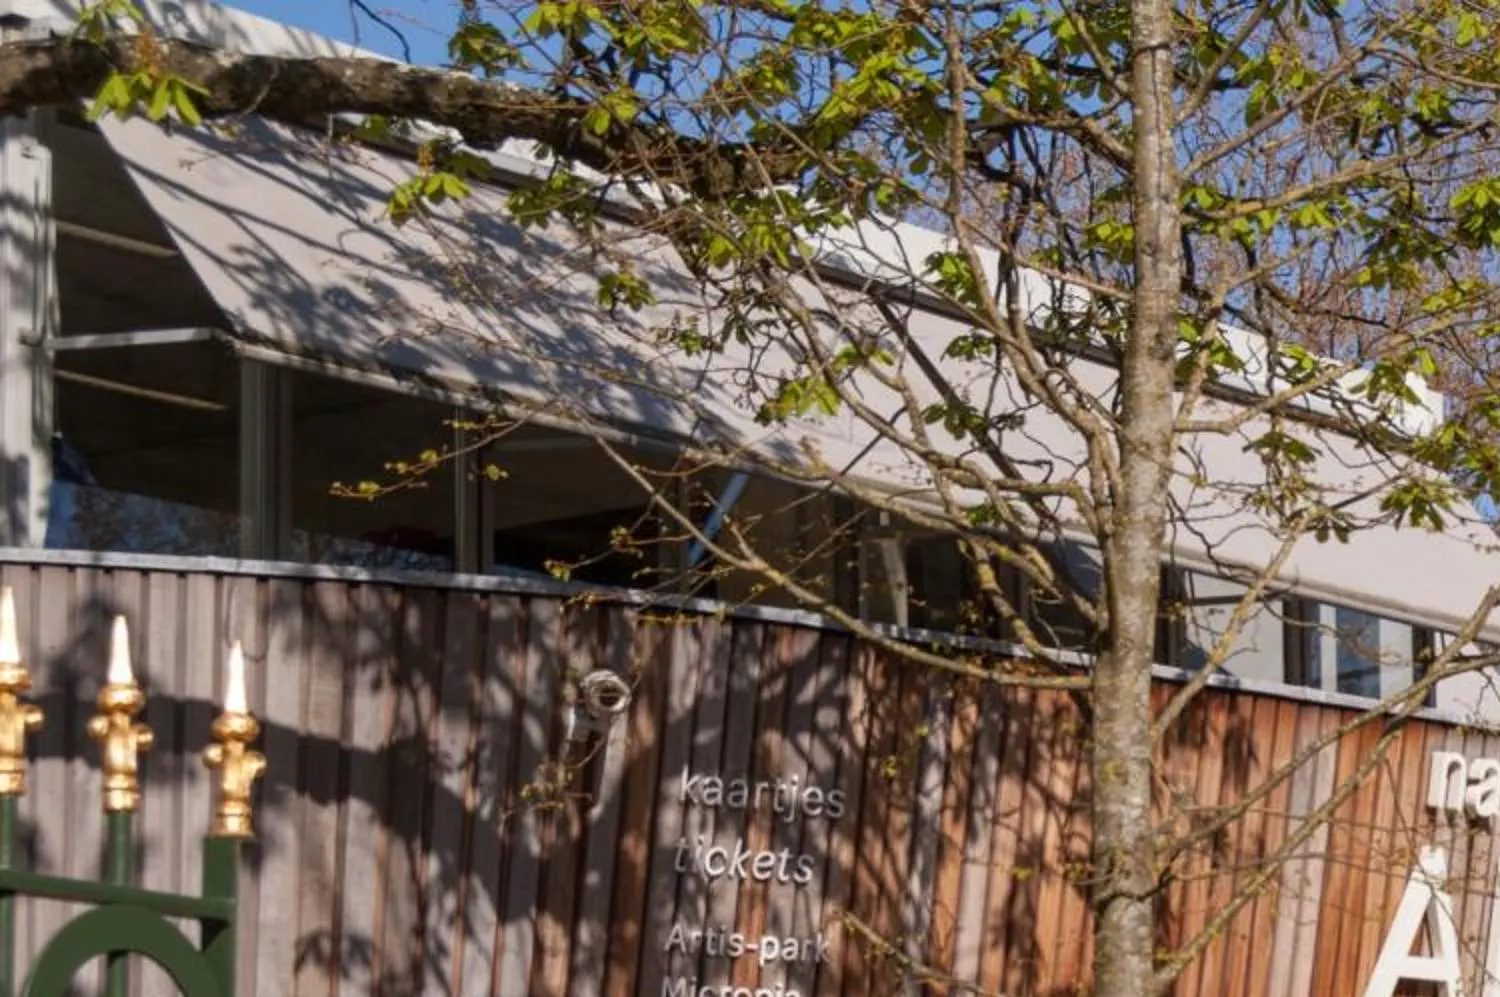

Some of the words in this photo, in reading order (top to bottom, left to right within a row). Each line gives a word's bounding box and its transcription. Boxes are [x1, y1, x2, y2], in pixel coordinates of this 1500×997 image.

[680, 763, 847, 822] kaartjes
[673, 836, 814, 884] tickets
[664, 921, 830, 966] Artis-park
